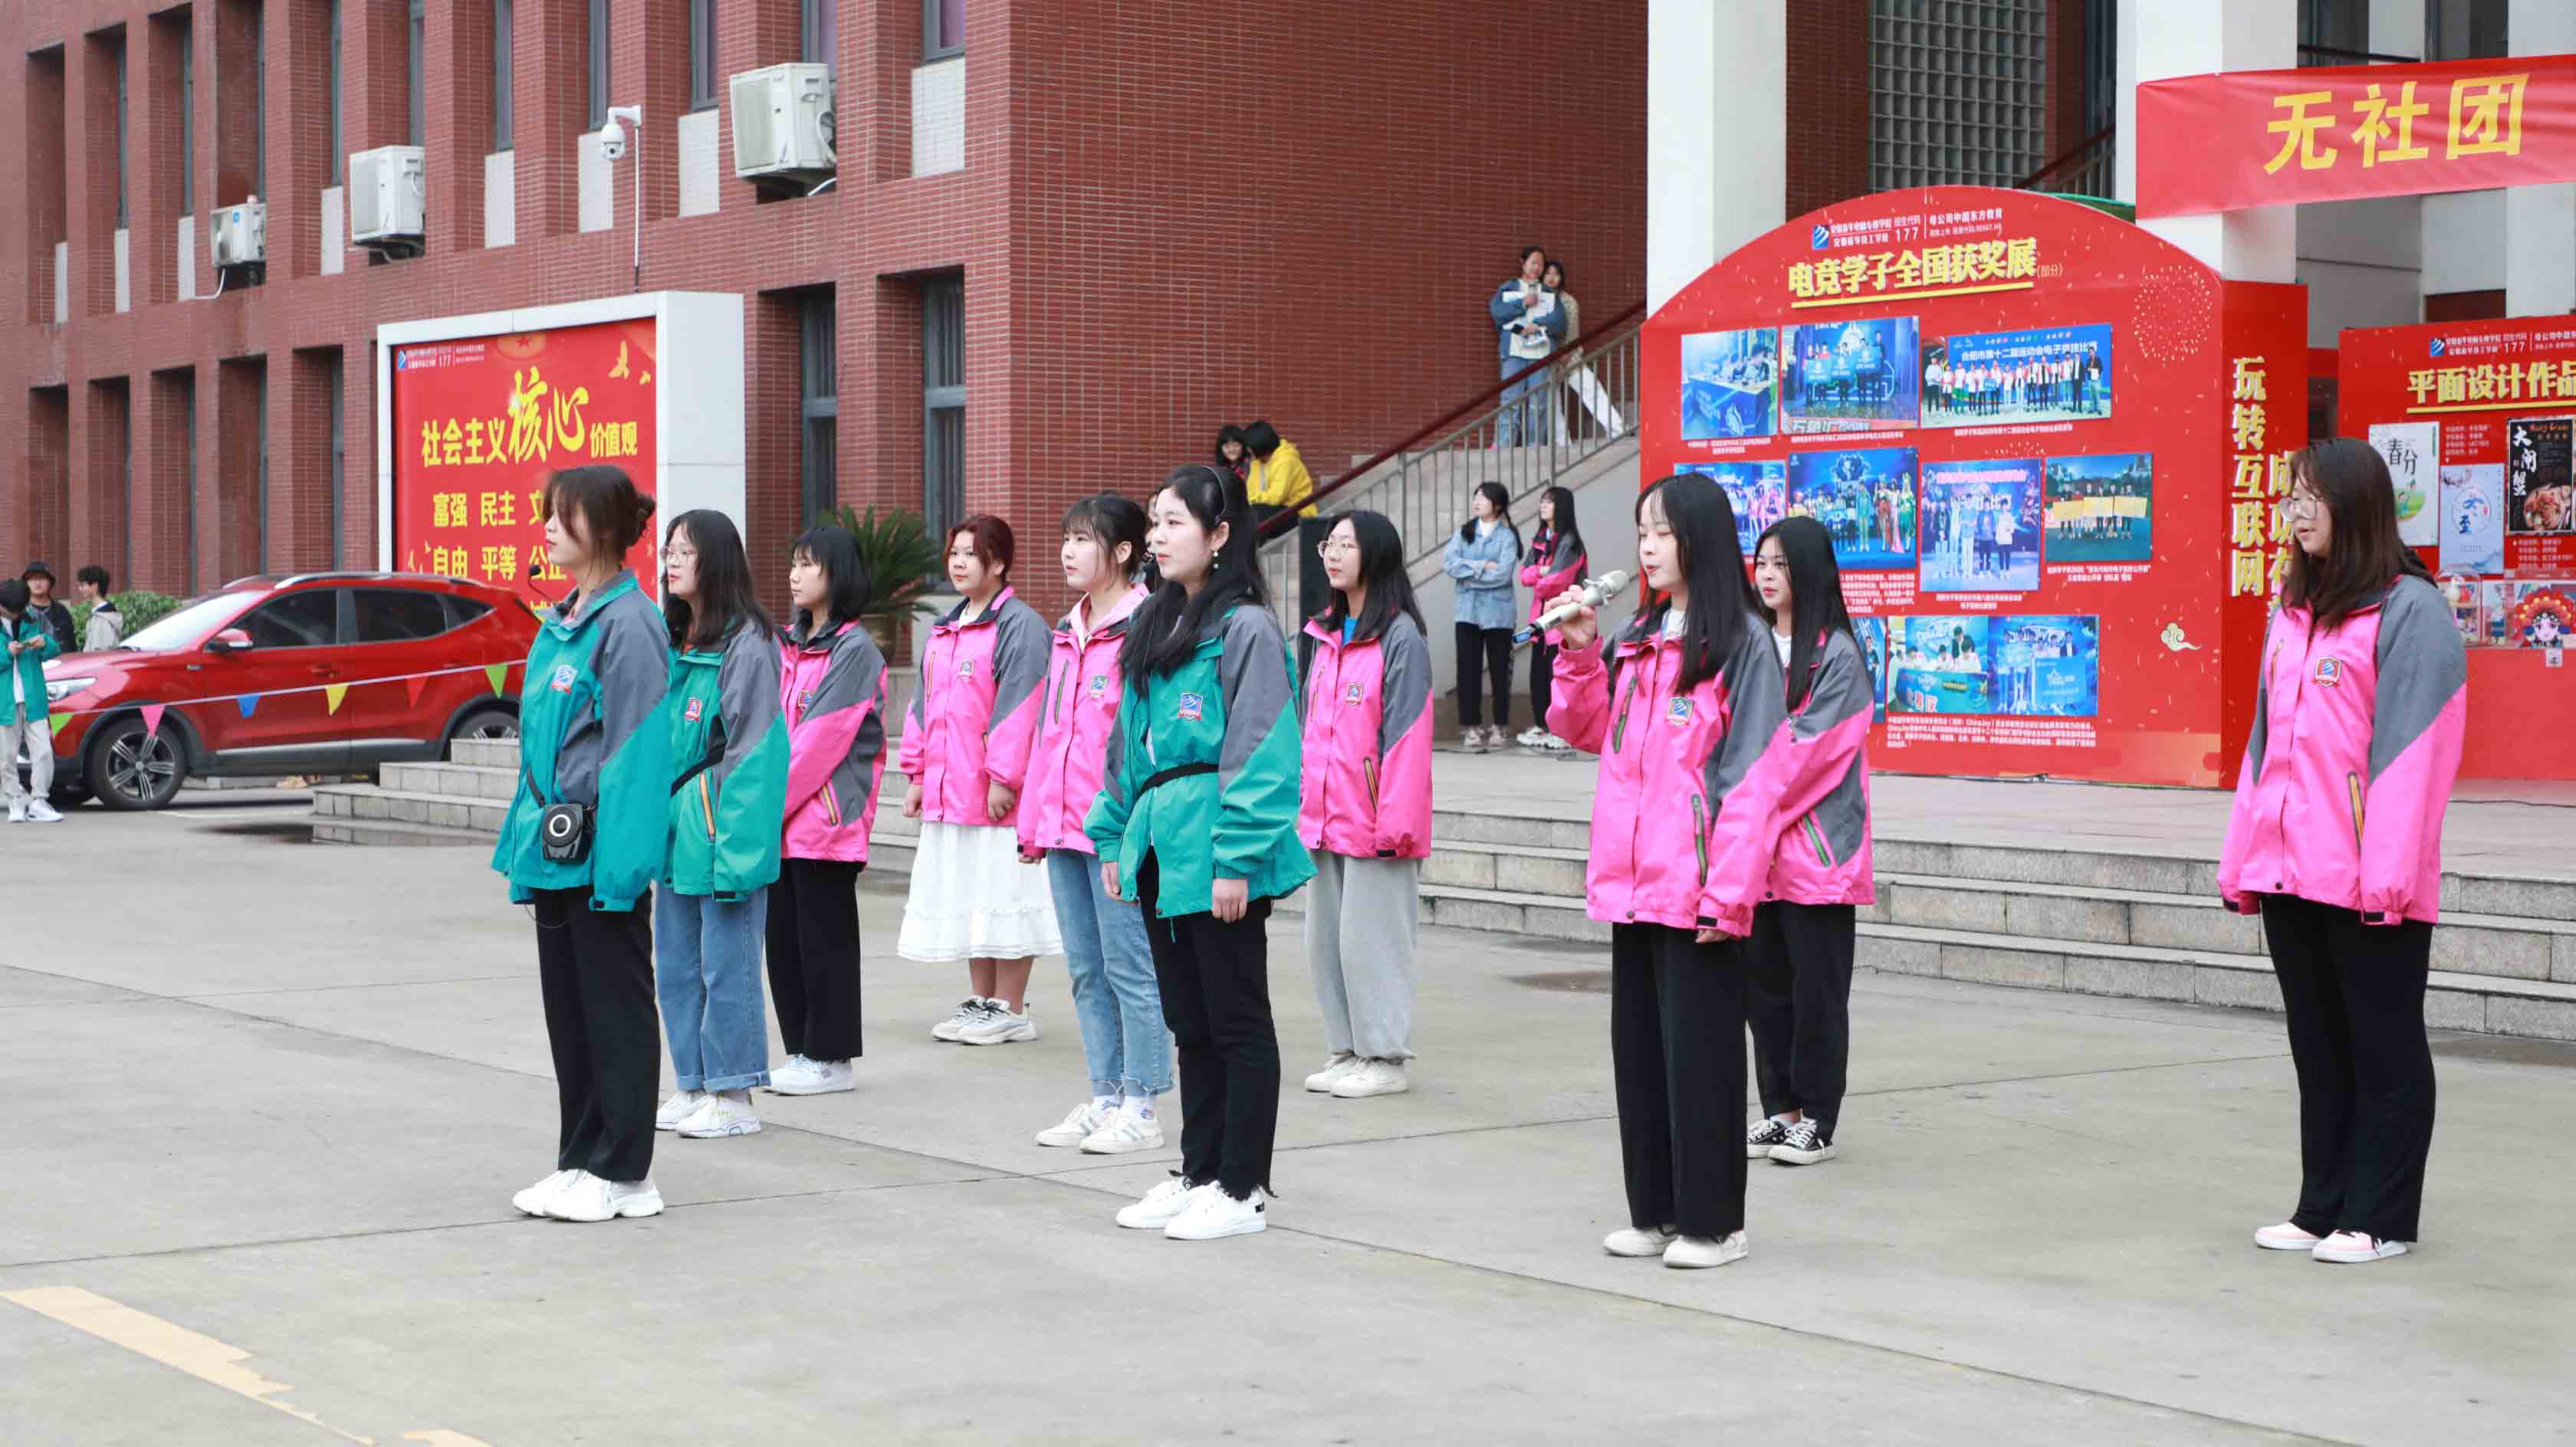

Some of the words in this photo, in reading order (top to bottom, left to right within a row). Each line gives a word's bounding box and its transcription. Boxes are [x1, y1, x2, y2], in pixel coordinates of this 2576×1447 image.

[2262, 73, 2530, 176] 无社团
[1895, 227, 1918, 242] 177
[1788, 238, 2036, 297] 电竞学子全国获奖展
[2407, 360, 2576, 404] 平面设计作品
[2232, 355, 2266, 597] 玩转互联网
[2387, 438, 2418, 475] 春分
[432, 491, 468, 527] 富强
[480, 491, 516, 526] 民主
[432, 546, 468, 578] 自由
[481, 546, 517, 581] 平等
